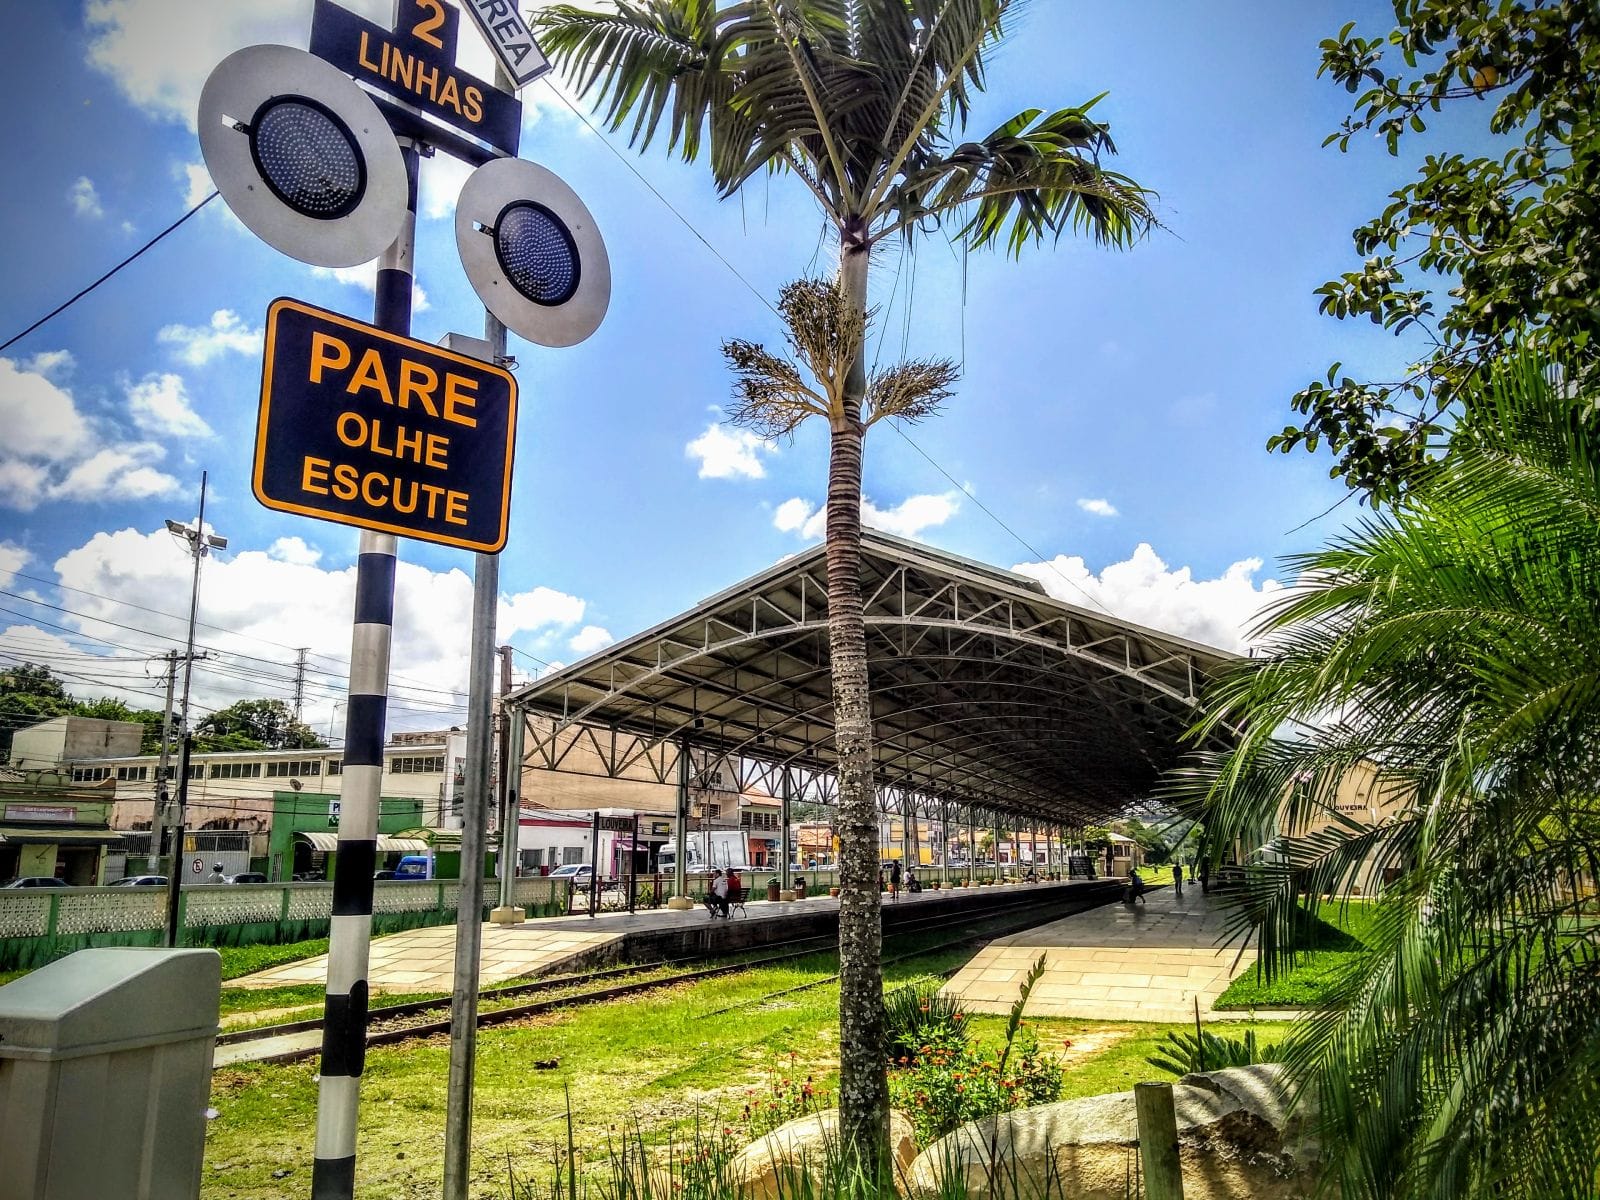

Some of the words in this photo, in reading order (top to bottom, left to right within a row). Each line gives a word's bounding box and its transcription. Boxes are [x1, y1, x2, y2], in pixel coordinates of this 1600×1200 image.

[412, 0, 445, 49] 2
[476, 0, 533, 67] REA
[358, 31, 483, 123] LINHAS
[308, 331, 479, 428] PARE
[336, 411, 450, 470] OLHE
[302, 455, 470, 526] ESCUTE
[601, 818, 633, 830] LOUVEIRA
